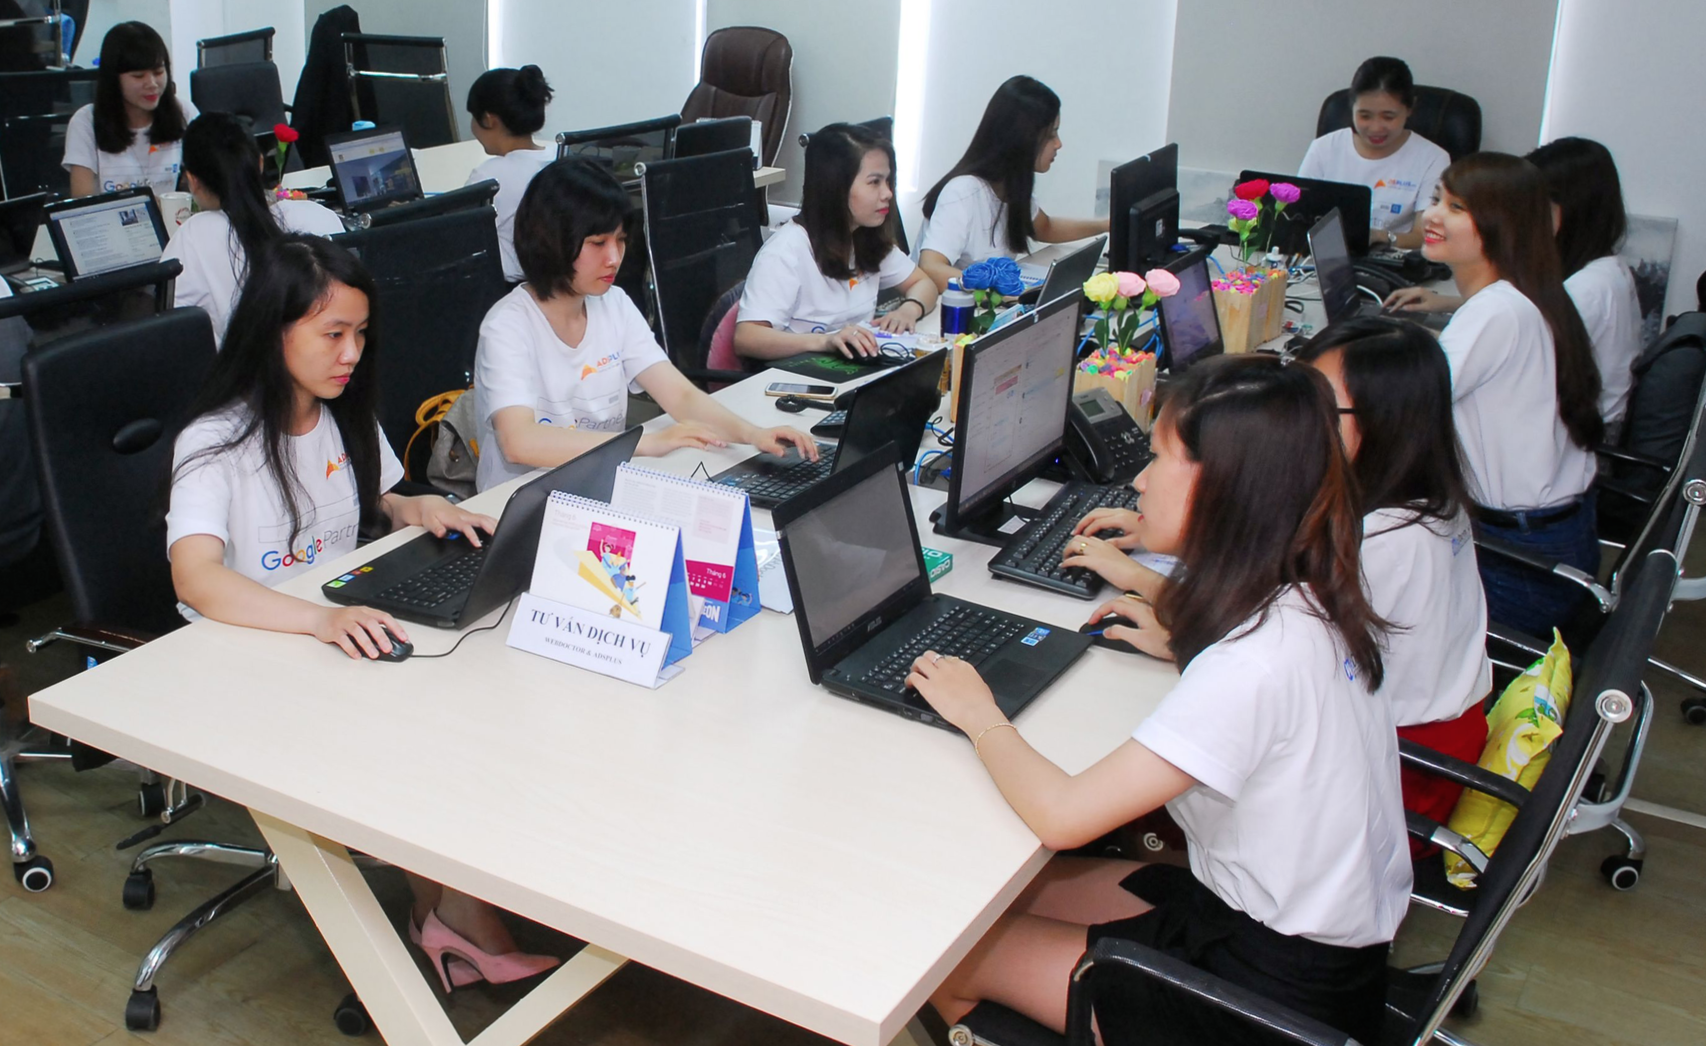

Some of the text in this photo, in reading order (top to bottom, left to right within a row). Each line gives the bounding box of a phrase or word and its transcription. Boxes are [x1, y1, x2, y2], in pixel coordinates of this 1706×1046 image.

[261, 535, 322, 571] Google
[531, 609, 553, 626] TƯ
[587, 626, 625, 648] DỊCH
[631, 638, 651, 658] VỤ
[545, 637, 586, 656] WEBDOCTOR
[594, 652, 622, 665] ADSPLUS
